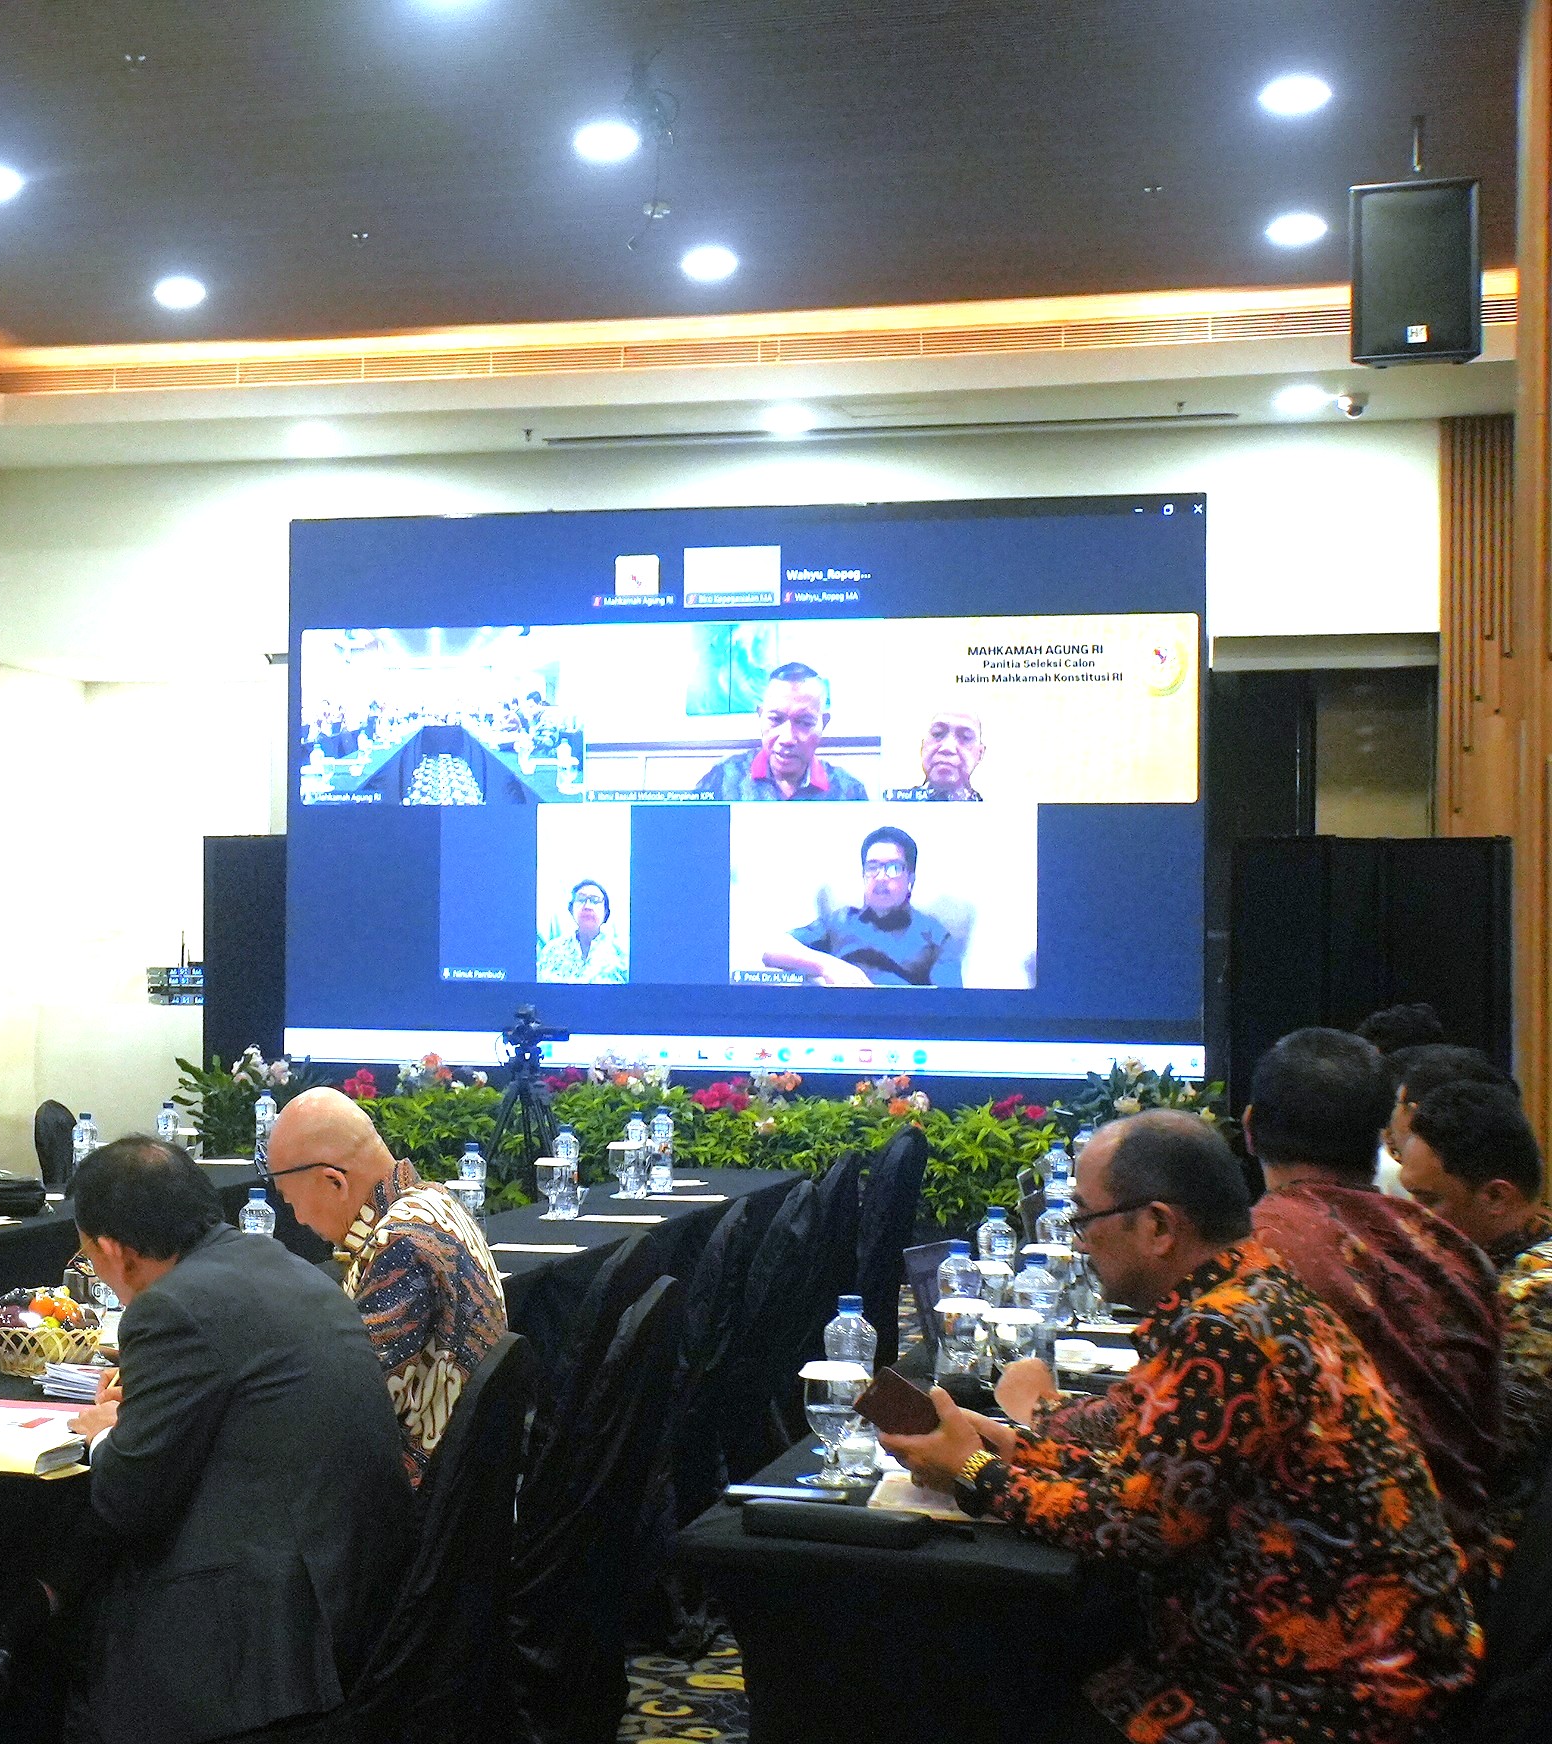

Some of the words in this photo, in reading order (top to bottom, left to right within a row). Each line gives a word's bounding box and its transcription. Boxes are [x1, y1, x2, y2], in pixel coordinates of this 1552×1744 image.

[967, 645, 1043, 656] MAHKAMAH
[1045, 644, 1089, 655] AGUNG
[1091, 644, 1104, 654] RI
[983, 659, 1021, 669] Panitia
[1023, 659, 1062, 668] Seleksi
[1064, 659, 1095, 668] Calon
[955, 674, 989, 684] Hakim
[991, 673, 1052, 683] Mahkamah
[1053, 673, 1110, 682] Konstitusi
[1112, 673, 1123, 682] RI
